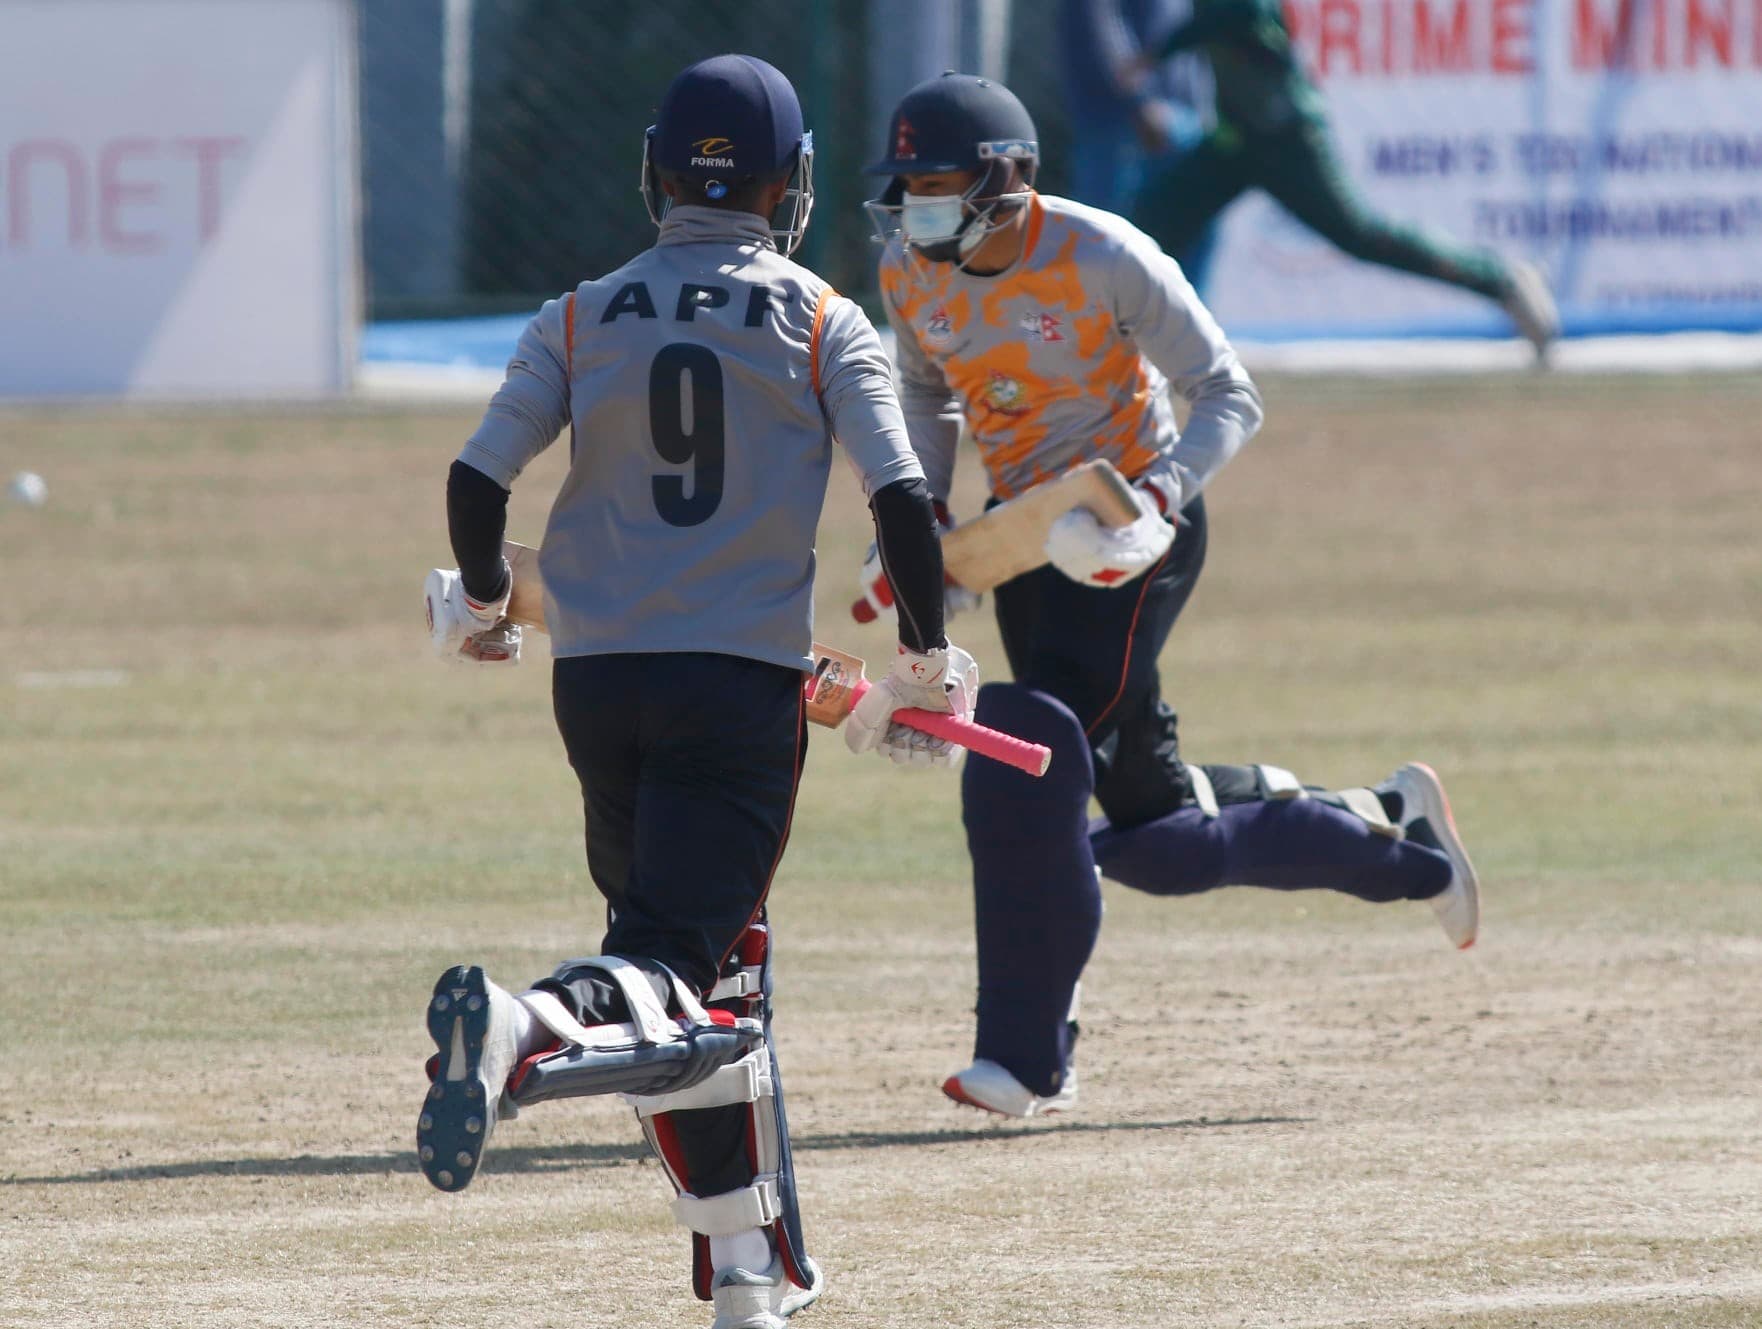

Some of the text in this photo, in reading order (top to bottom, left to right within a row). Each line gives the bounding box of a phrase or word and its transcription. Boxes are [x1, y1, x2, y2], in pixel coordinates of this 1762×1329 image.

[691, 157, 735, 168] FORMA
[600, 281, 795, 328] APF
[649, 342, 725, 528] 9
